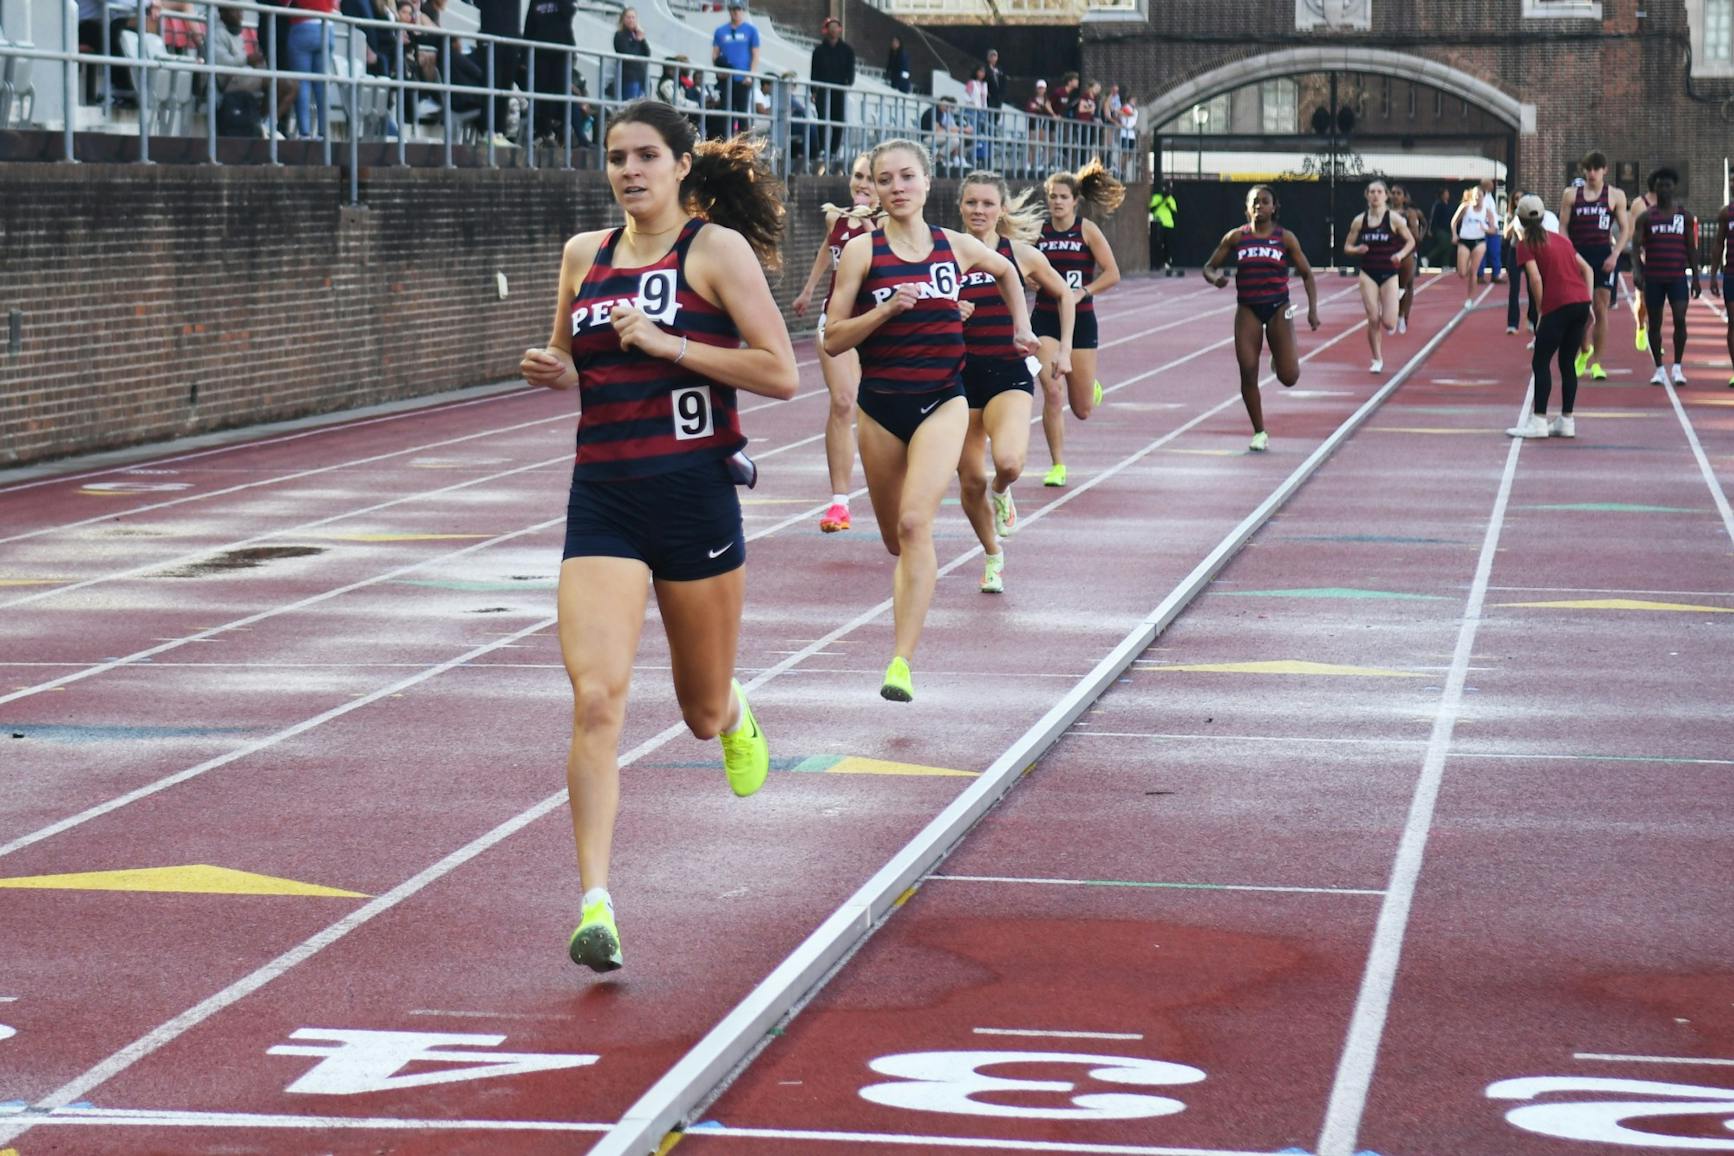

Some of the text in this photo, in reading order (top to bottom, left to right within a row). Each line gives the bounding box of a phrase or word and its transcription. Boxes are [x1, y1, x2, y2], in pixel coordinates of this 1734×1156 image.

[1039, 240, 1082, 251] PENN
[1238, 246, 1283, 261] PENN
[643, 273, 670, 315] 9
[935, 265, 954, 295] 6
[960, 272, 997, 287] PEN
[1069, 272, 1080, 289] 2
[678, 390, 708, 435] 9
[266, 1028, 601, 1094] 4
[857, 1050, 1207, 1119] 3
[1485, 1076, 1734, 1149] 2
